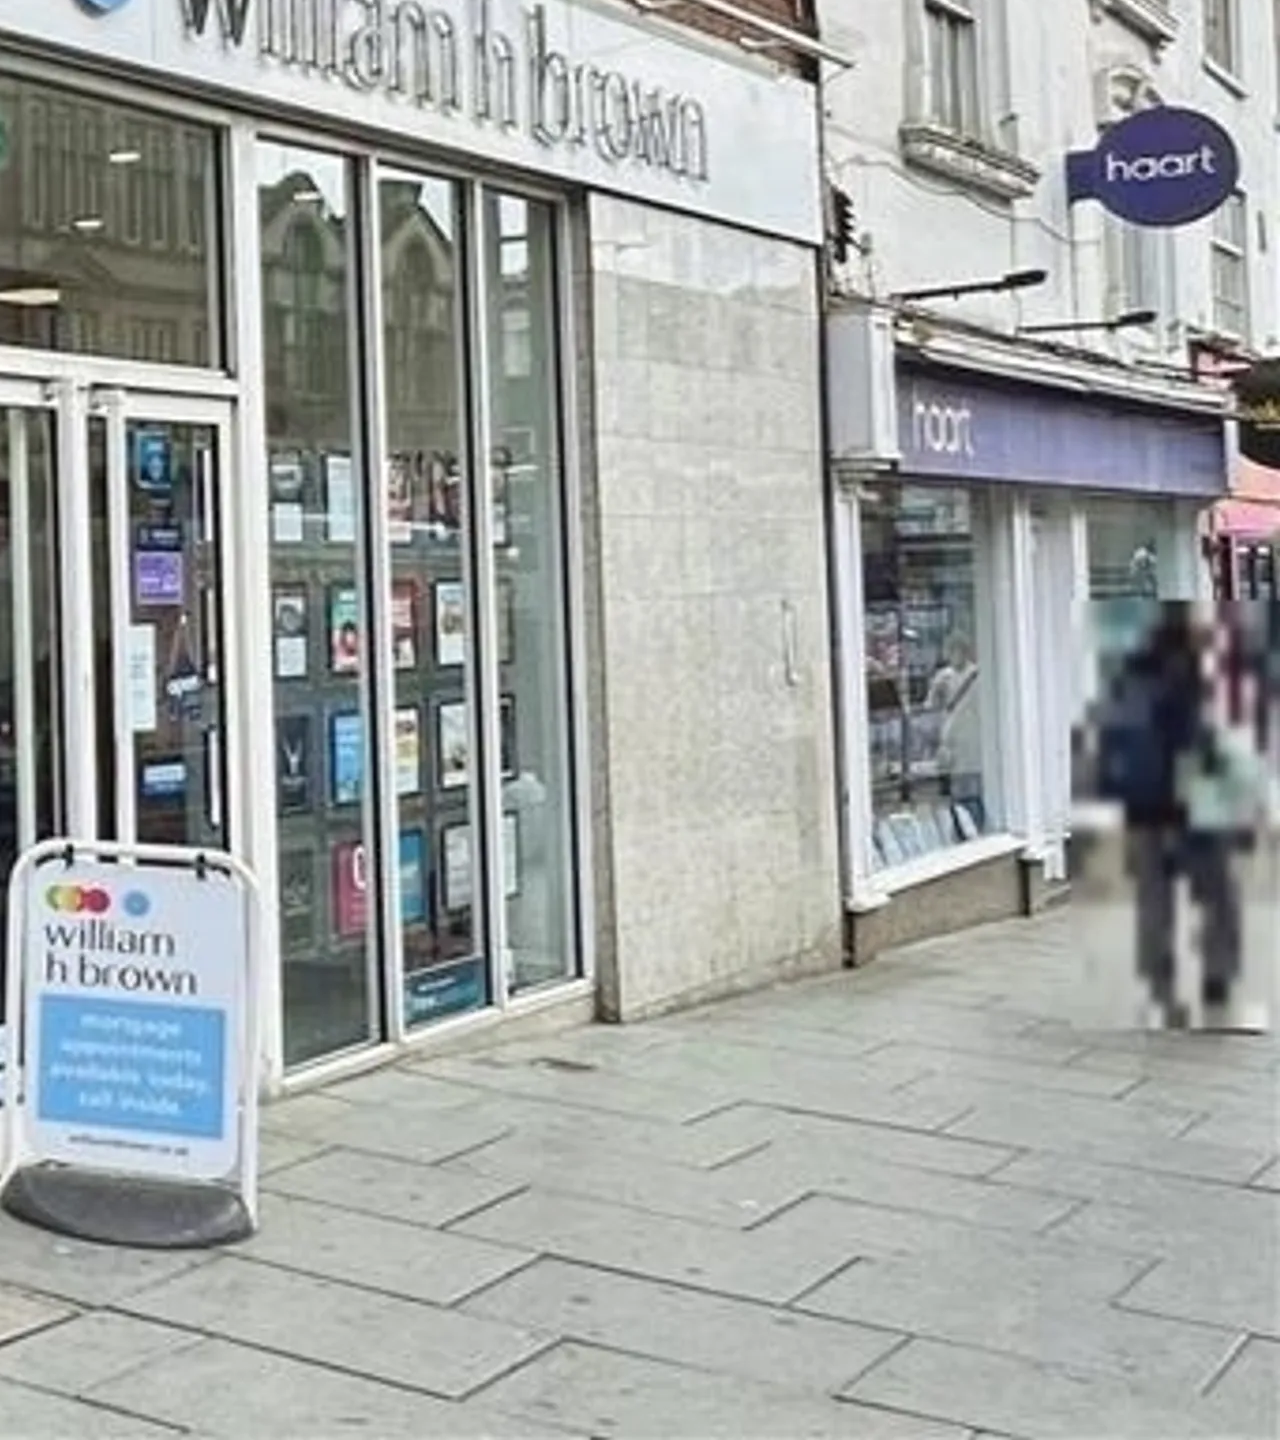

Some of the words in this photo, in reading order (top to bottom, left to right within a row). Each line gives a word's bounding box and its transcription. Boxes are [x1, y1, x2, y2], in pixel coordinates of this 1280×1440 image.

[525, 2, 710, 182] brown
[1106, 145, 1217, 183] haart
[912, 382, 976, 458] haart
[44, 919, 176, 957] william
[46, 952, 67, 984] h
[79, 953, 198, 995] brown
